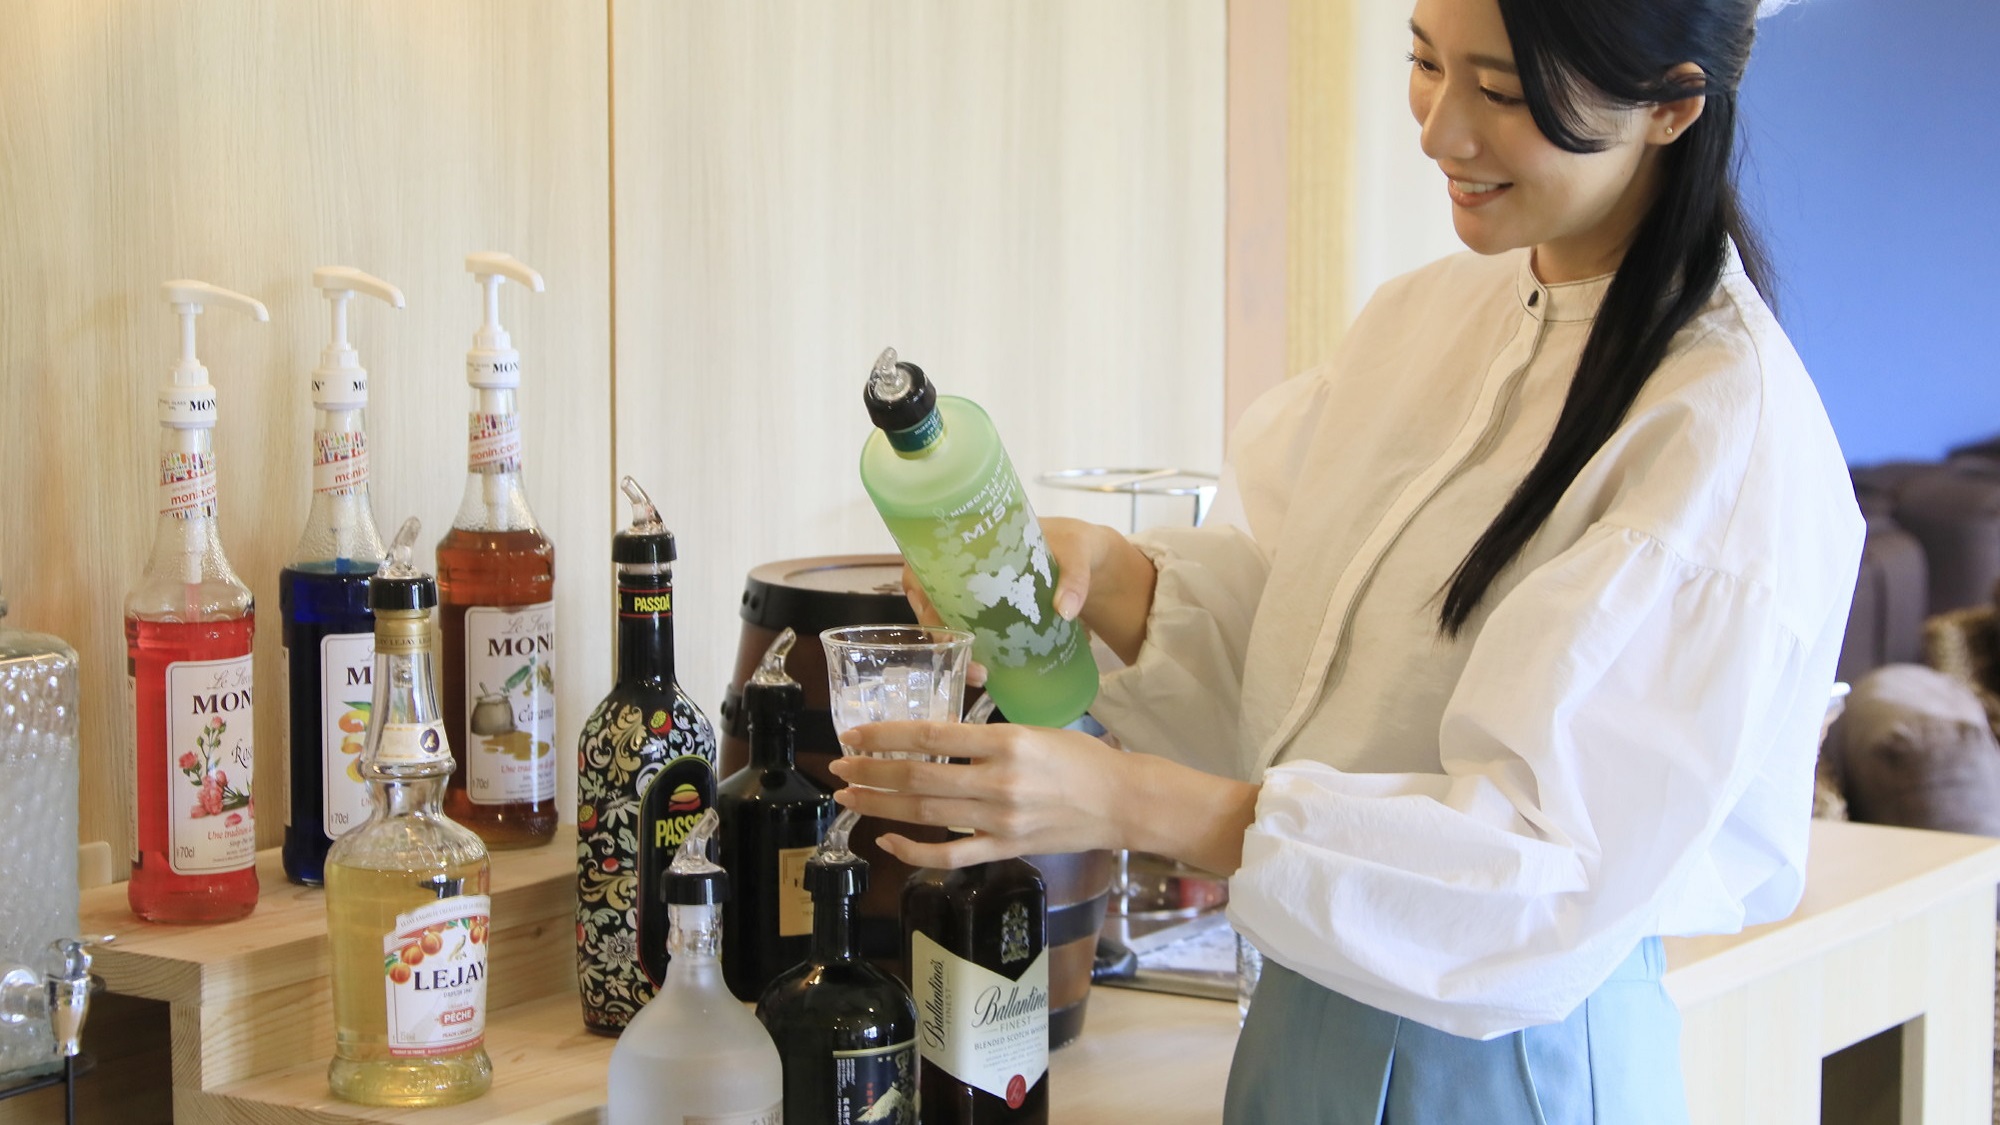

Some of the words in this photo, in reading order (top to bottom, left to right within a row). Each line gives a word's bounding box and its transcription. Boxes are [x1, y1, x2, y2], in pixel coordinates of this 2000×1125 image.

[950, 484, 990, 518] MUSCAT
[414, 961, 484, 991] LEJAY
[921, 959, 945, 1052] Ballantine's
[1000, 1015, 1031, 1032] FINEST
[974, 1037, 1005, 1050] BLENDED
[1006, 1031, 1030, 1042] SCOTCH
